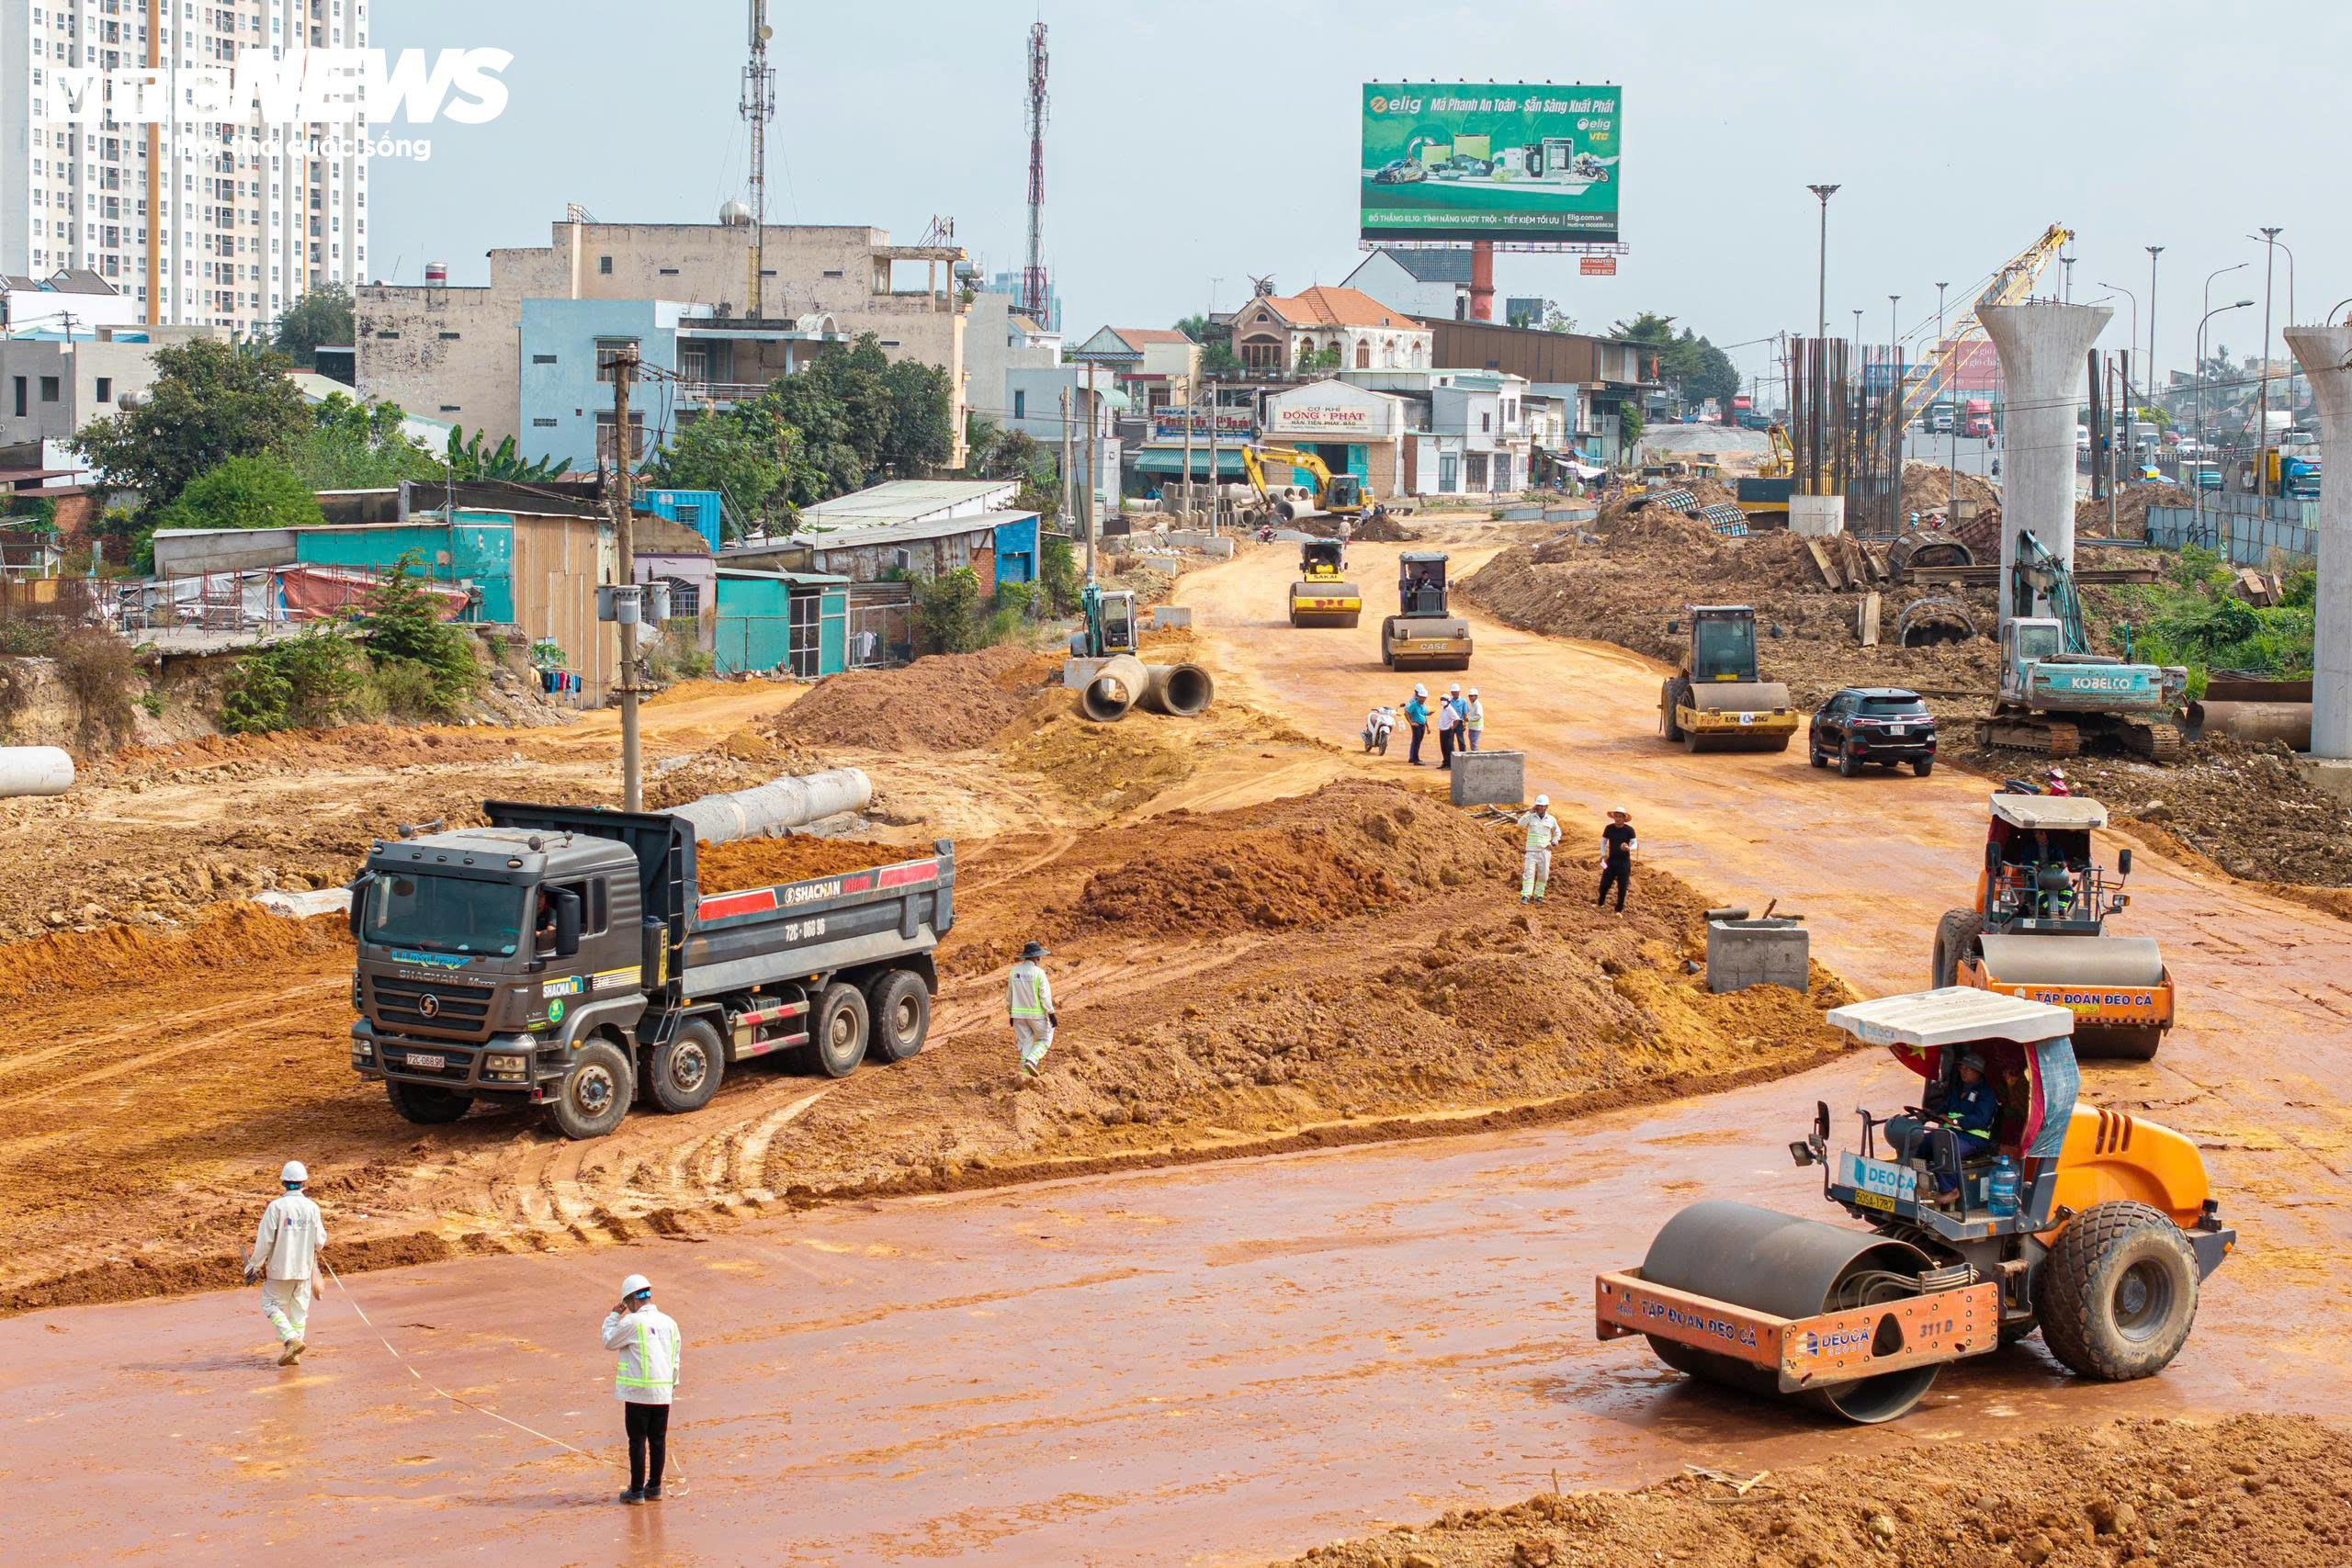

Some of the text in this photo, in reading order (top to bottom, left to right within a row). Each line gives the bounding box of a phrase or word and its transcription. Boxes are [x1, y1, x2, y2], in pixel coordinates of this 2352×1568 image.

[1389, 96, 1421, 114] elig
[1431, 97, 1447, 111] Má
[1449, 98, 1477, 111] Phanh
[1479, 98, 1491, 111] An
[1495, 98, 1516, 112] Toàn
[1544, 98, 1567, 114] Sàng
[1569, 98, 1590, 113] Xuất
[1592, 99, 1614, 113] Phát
[1589, 118, 1611, 130] elig
[1330, 411, 1365, 421] PHÁT
[2073, 677, 2130, 689] KOBELCO
[795, 880, 841, 904] SHACMAN
[391, 950, 471, 970] LUXURY
[399, 969, 459, 986] SHACMAN
[2064, 991, 2100, 1005] ĐOÀN
[2105, 992, 2131, 1005] ĐÈO
[2135, 992, 2153, 1006] CẢ
[1869, 1168, 1916, 1191] DEOCA
[1919, 1319, 1953, 1337] 311 D
[1822, 1328, 1870, 1348] DEOCA
